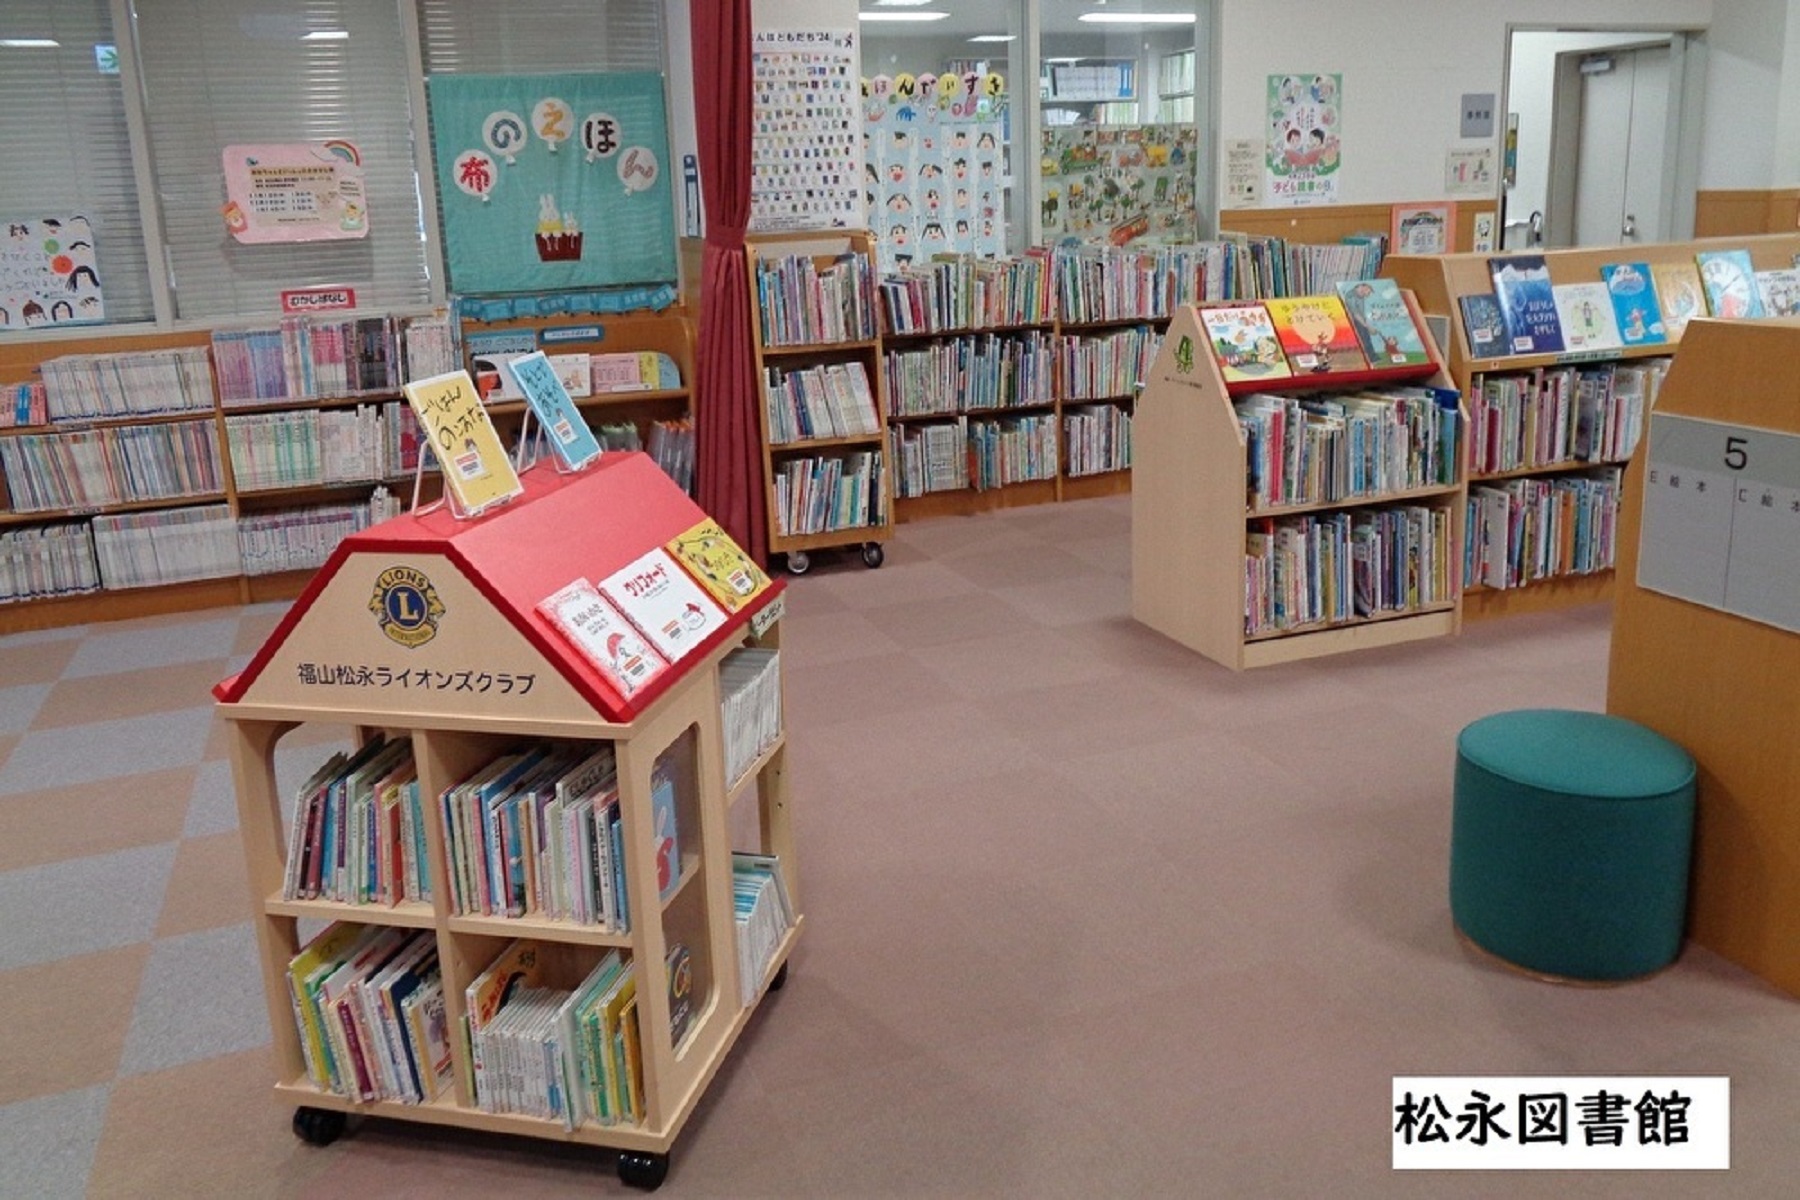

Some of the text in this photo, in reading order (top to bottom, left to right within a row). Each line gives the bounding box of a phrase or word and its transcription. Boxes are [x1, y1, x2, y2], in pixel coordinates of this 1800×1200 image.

[1724, 436, 1748, 470] 5
[382, 568, 426, 588] LIONS
[397, 591, 419, 620] L
[297, 662, 536, 695] 福山松永ライオンズクラブ
